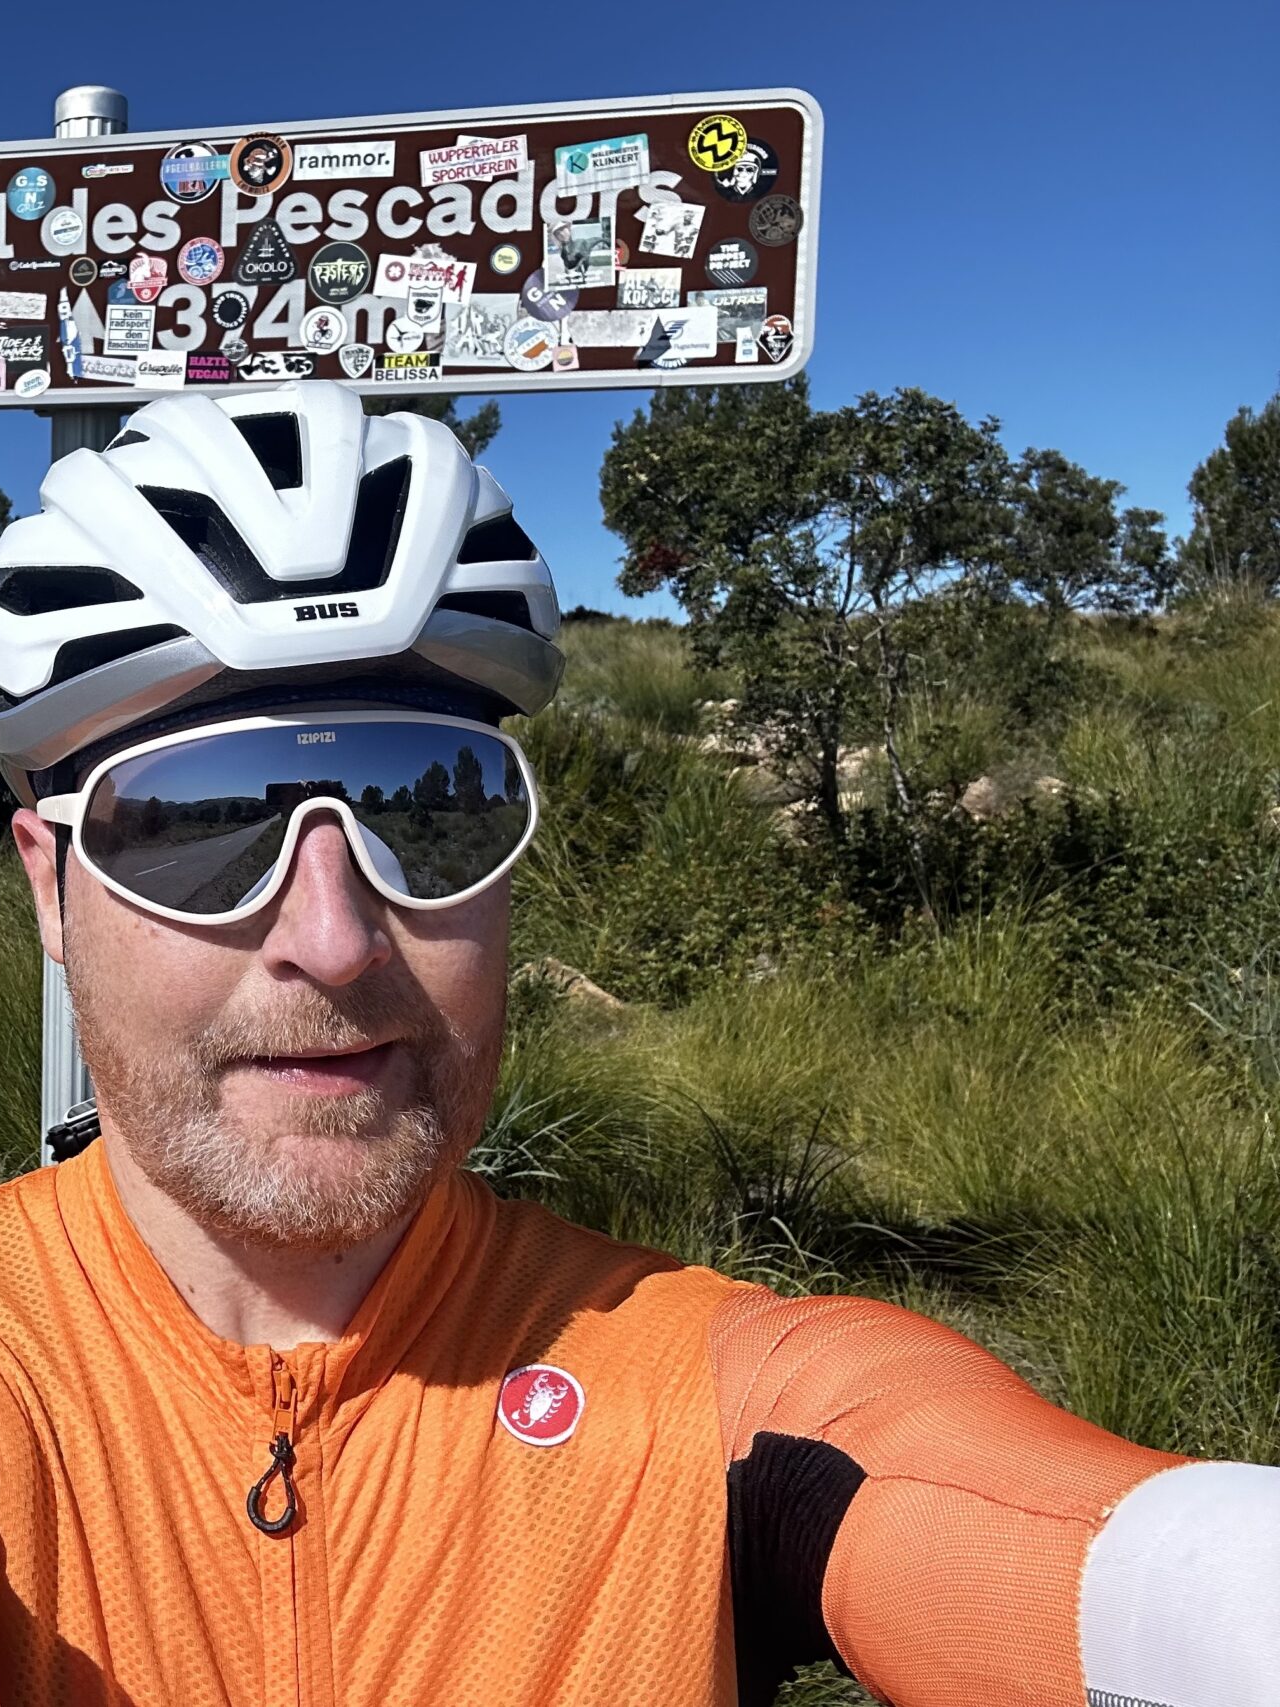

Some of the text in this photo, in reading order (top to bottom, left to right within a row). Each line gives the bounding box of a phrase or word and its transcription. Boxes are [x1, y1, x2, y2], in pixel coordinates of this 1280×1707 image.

[428, 139, 519, 164] WUPPERTALER
[299, 152, 390, 169] rammor.
[592, 152, 639, 168] KLINKERT
[432, 158, 517, 183] SPORTVEREIN
[40, 188, 181, 256] des
[245, 261, 288, 274] OKOLO
[713, 294, 765, 306] ULTRAS
[123, 309, 143, 319] kein
[125, 329, 143, 339] den
[385, 354, 429, 368] TEAM
[188, 369, 229, 380] VEGAN
[375, 367, 439, 381] BELISSA
[293, 602, 360, 622] BUS
[297, 731, 336, 745] IZIPIZI
